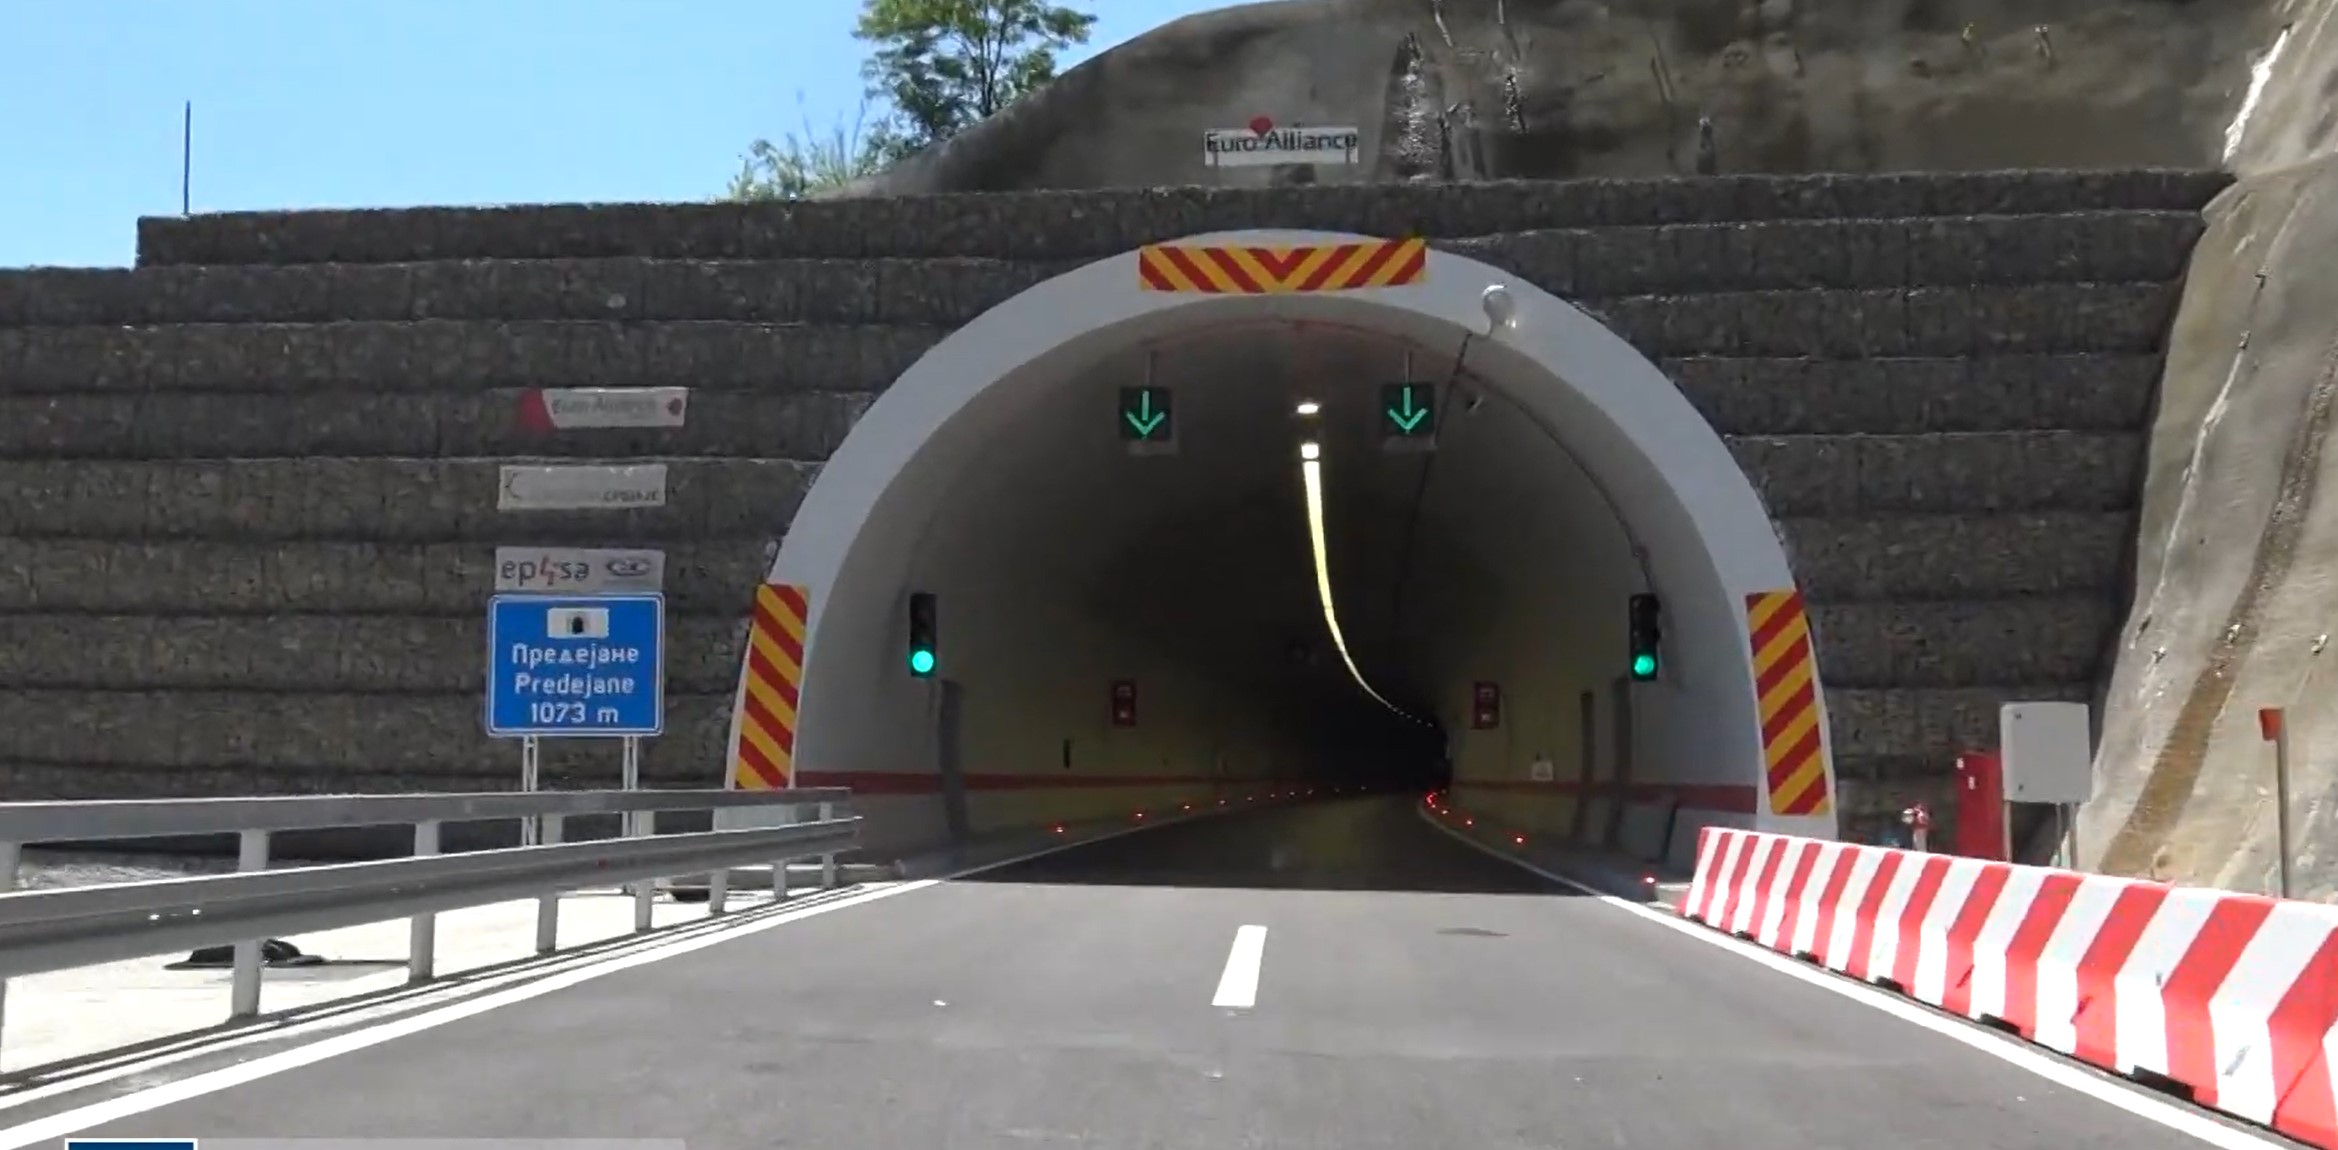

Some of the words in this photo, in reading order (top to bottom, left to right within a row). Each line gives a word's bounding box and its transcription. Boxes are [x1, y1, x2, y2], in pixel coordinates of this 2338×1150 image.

[1206, 133, 1257, 152] Euro
[1265, 131, 1357, 151] Alliance
[512, 643, 639, 670] Предејане
[514, 672, 635, 698] Predejane
[531, 702, 586, 723] 1073
[597, 707, 619, 723] m
